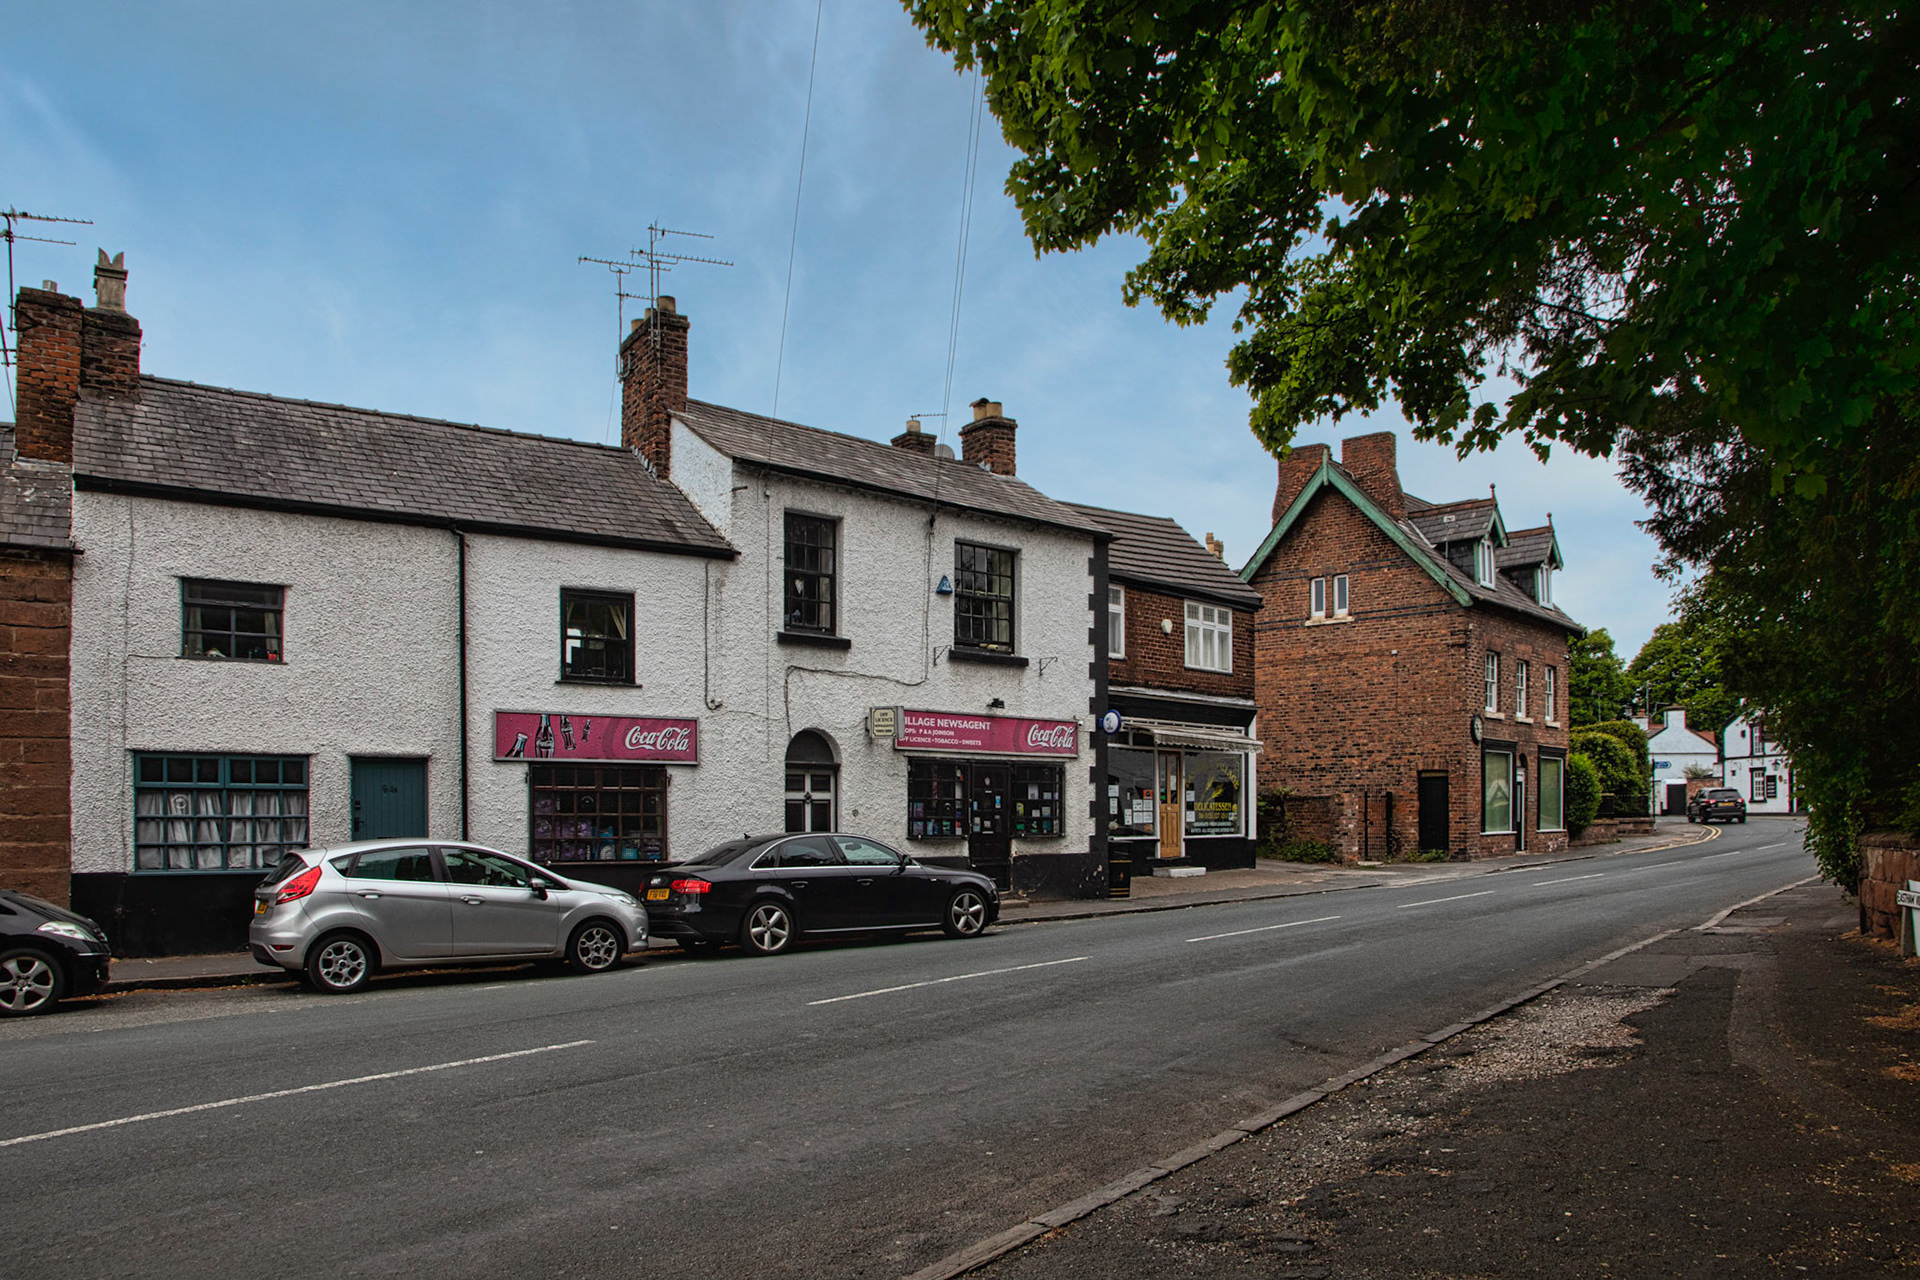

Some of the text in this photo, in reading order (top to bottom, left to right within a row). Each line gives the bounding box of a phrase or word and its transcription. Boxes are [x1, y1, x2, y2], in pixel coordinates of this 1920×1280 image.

[904, 716, 991, 730] ILLAGE NEWSAGENT
[625, 726, 691, 751] Coca-Cola
[1027, 724, 1075, 749] Coca-Cola
[1194, 802, 1232, 811] DELICATESSEN
